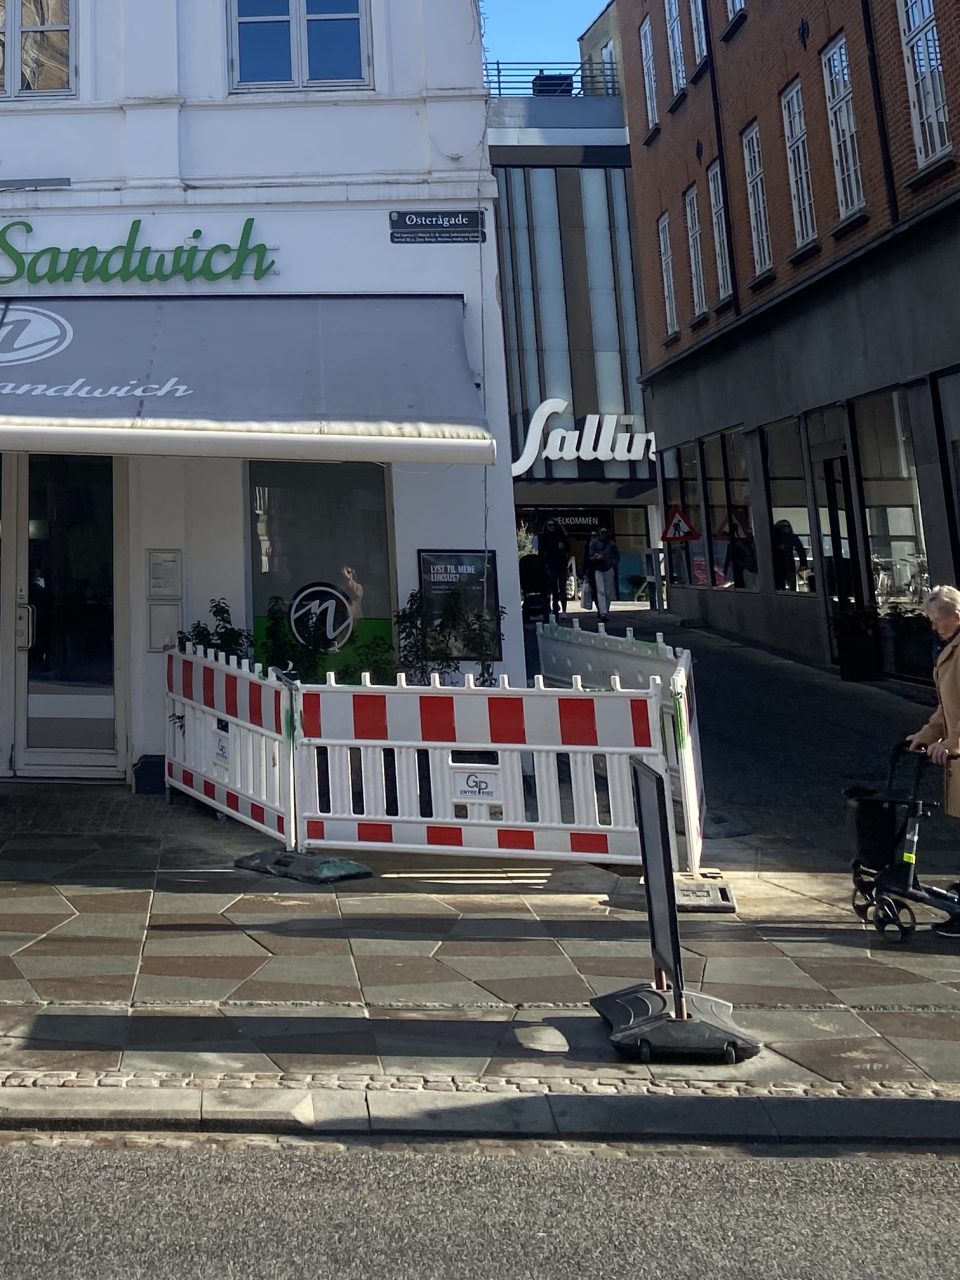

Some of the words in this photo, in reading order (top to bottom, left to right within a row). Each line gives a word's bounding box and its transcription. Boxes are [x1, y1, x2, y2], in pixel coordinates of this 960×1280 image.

[405, 214, 469, 227] Østerågade
[430, 565, 445, 574] LYST
[447, 565, 457, 574] TIL
[466, 774, 488, 794] GP
